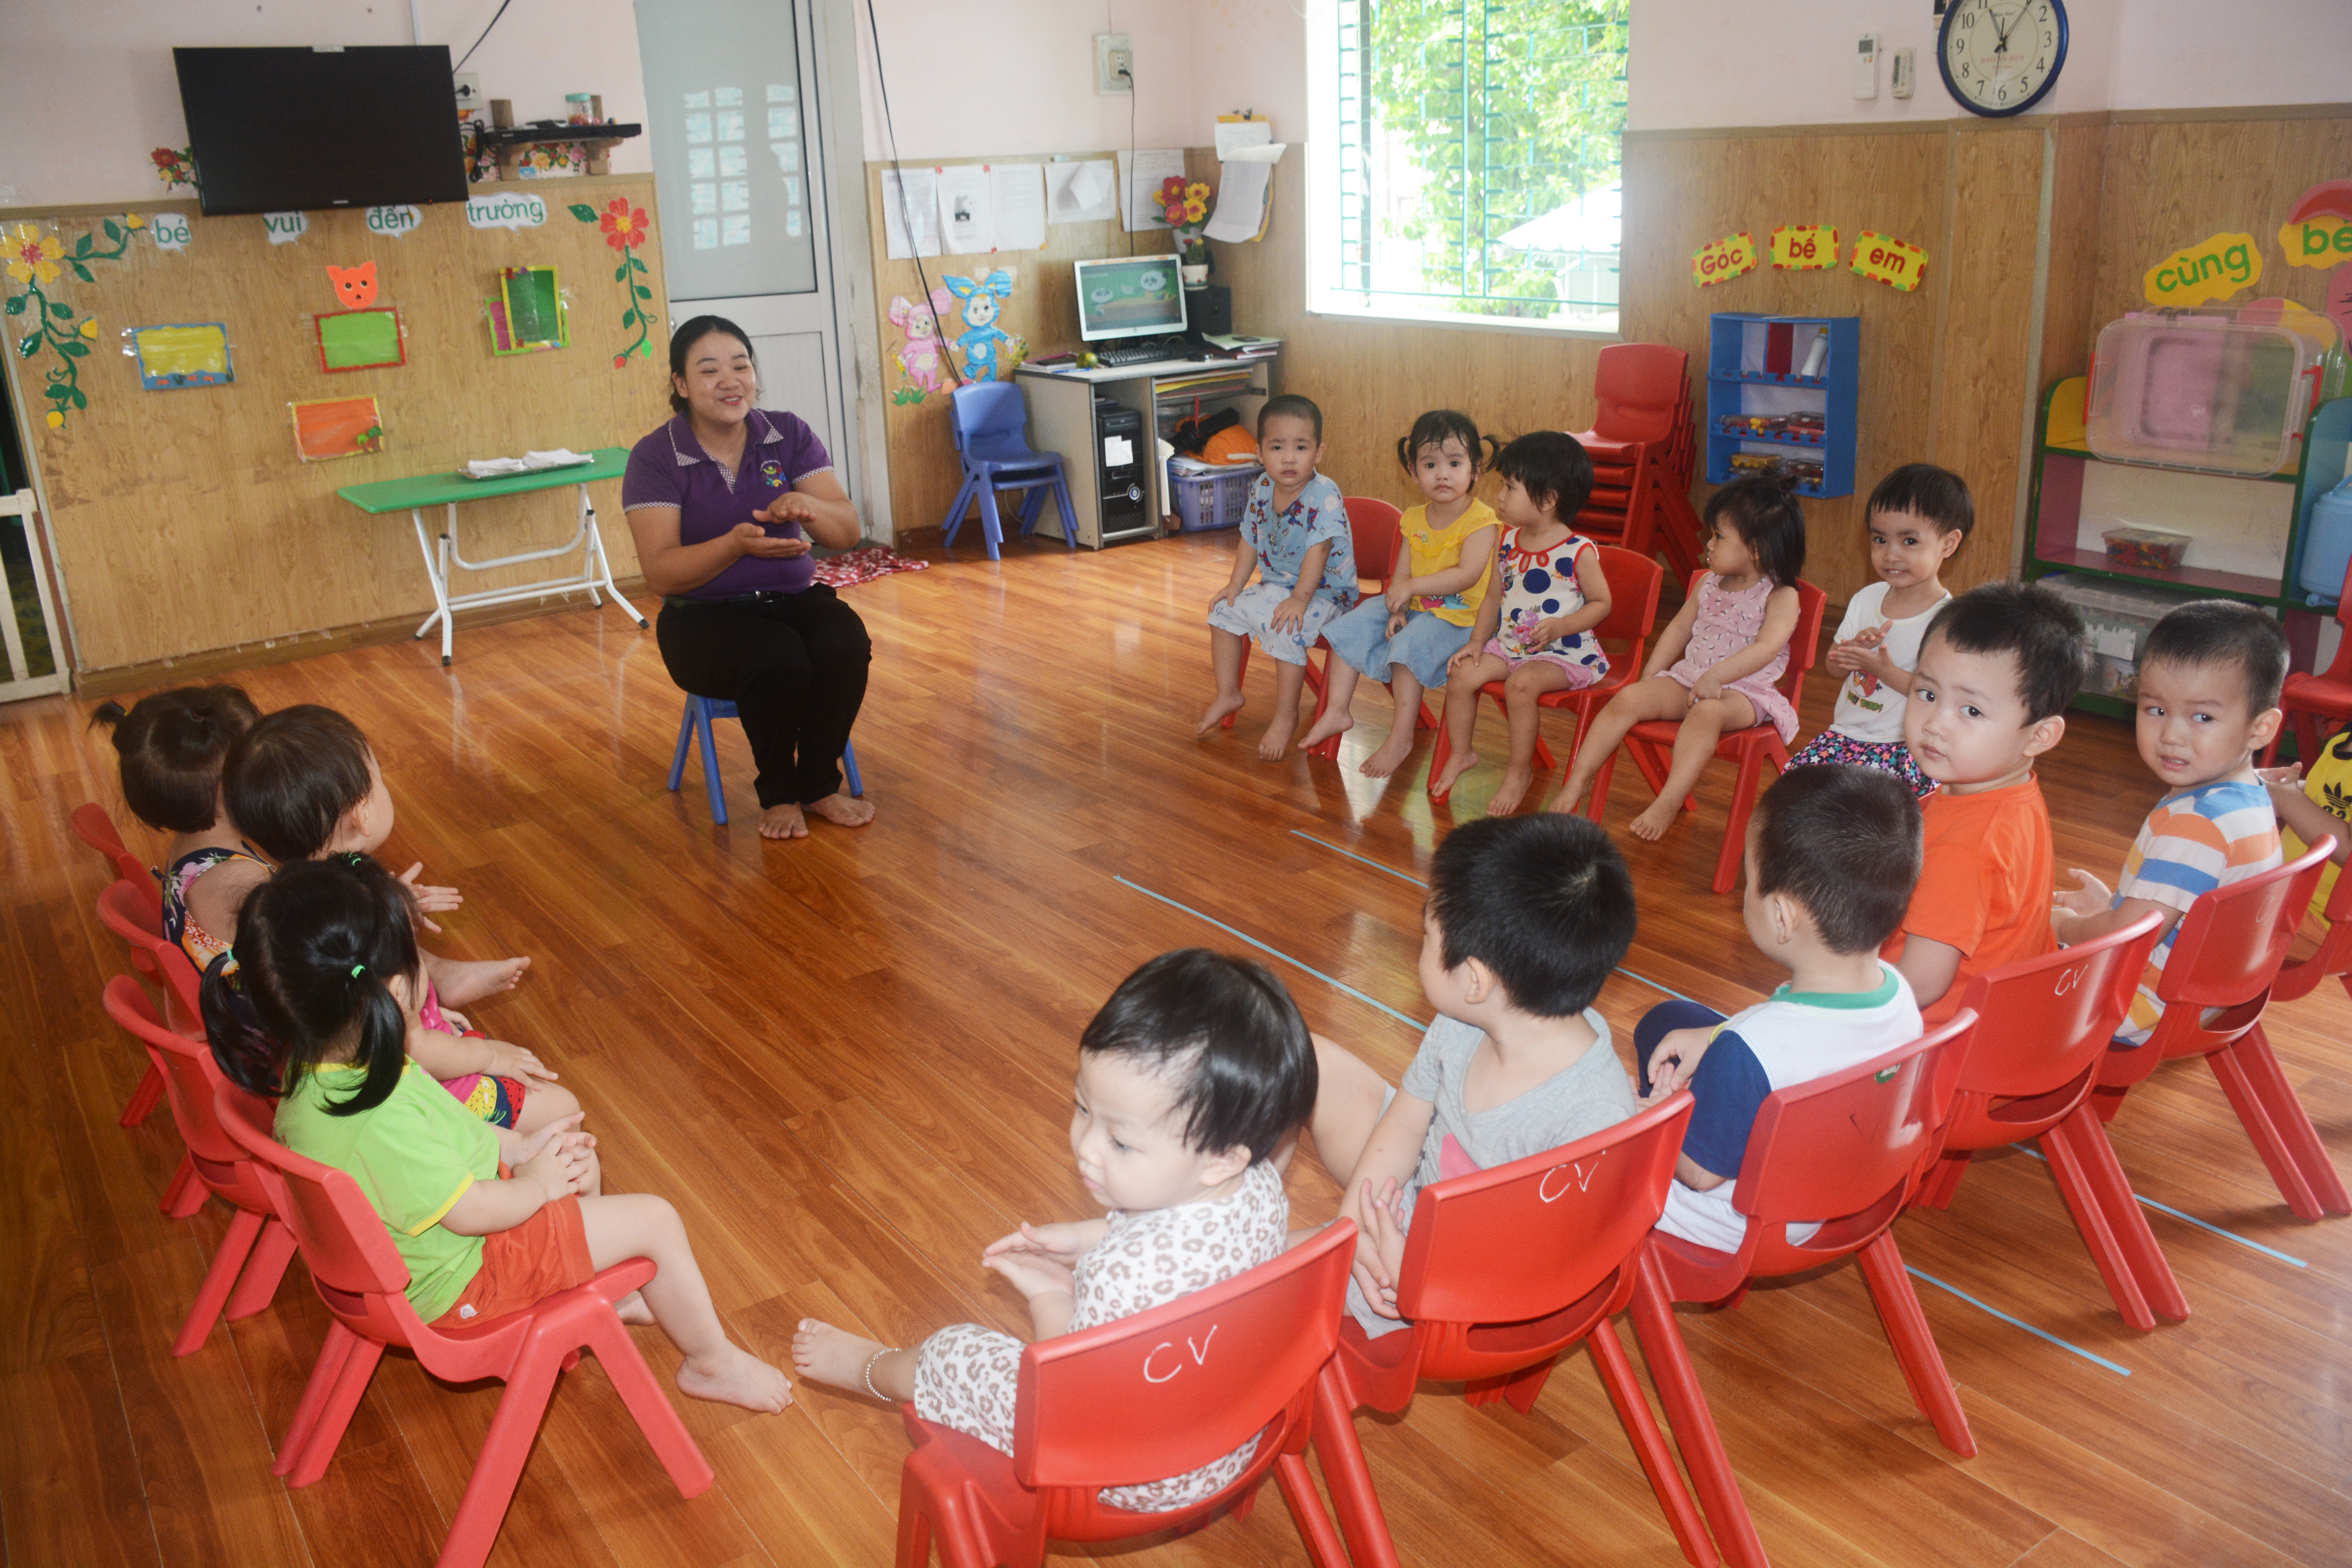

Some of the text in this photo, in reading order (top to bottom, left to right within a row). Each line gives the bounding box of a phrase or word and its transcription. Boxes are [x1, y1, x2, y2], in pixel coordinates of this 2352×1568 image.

[1962, 12, 1975, 29] 10
[2039, 5, 2047, 22] 2
[1956, 38, 1965, 55] 9
[2043, 31, 2052, 48] 3
[1962, 62, 1969, 78] 8
[2036, 57, 2045, 73] 4
[1977, 80, 1985, 96] 7
[1998, 84, 2007, 101] 6
[2020, 76, 2028, 93] 5
[155, 218, 190, 243] bé
[262, 211, 301, 233] vui
[468, 199, 543, 223] trường
[1700, 247, 1743, 276] Góc
[1869, 248, 1906, 274] em
[2156, 220, 2352, 292] cùng bé
[2054, 964, 2089, 996] CV
[1539, 1150, 1606, 1203] CV
[1144, 1324, 1218, 1383] CV
